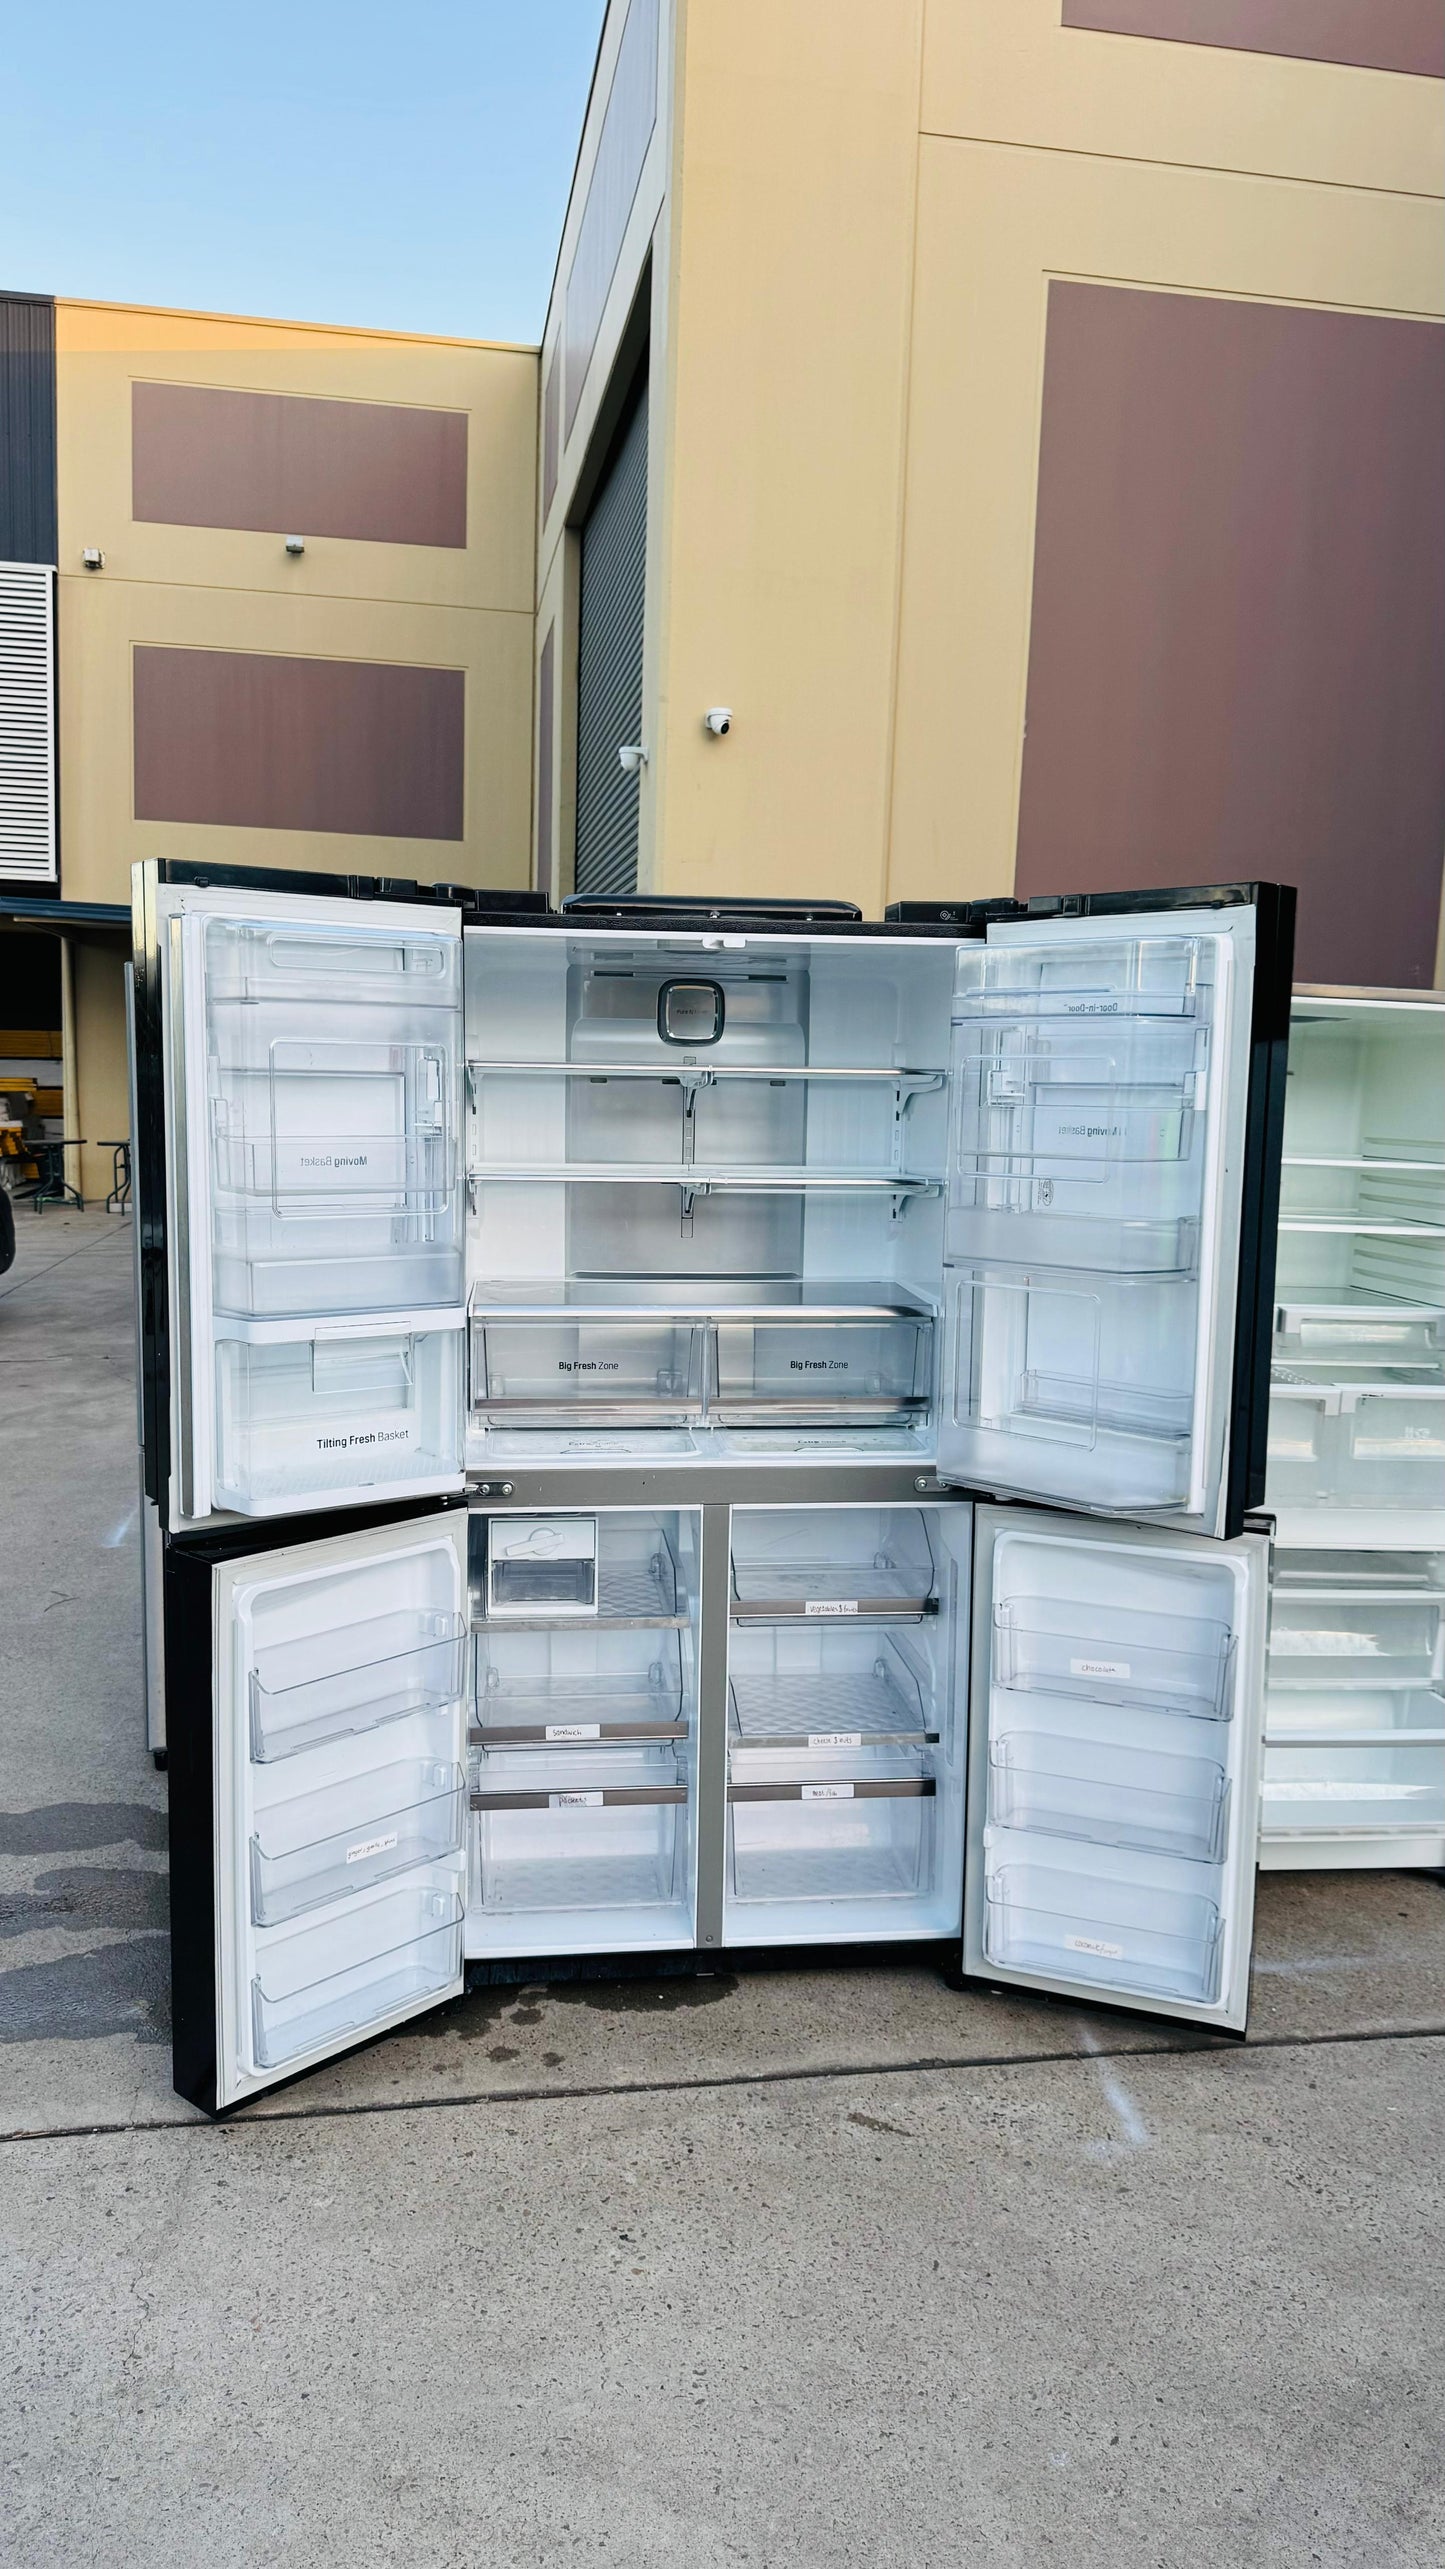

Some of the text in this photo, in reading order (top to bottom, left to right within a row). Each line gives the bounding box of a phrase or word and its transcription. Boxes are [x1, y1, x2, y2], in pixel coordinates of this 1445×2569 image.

[558, 1361, 619, 1373] Big Fresh Zone
[790, 1360, 849, 1371] Big Fresh Zone
[316, 1429, 409, 1449] Tilting Fresh Basket
